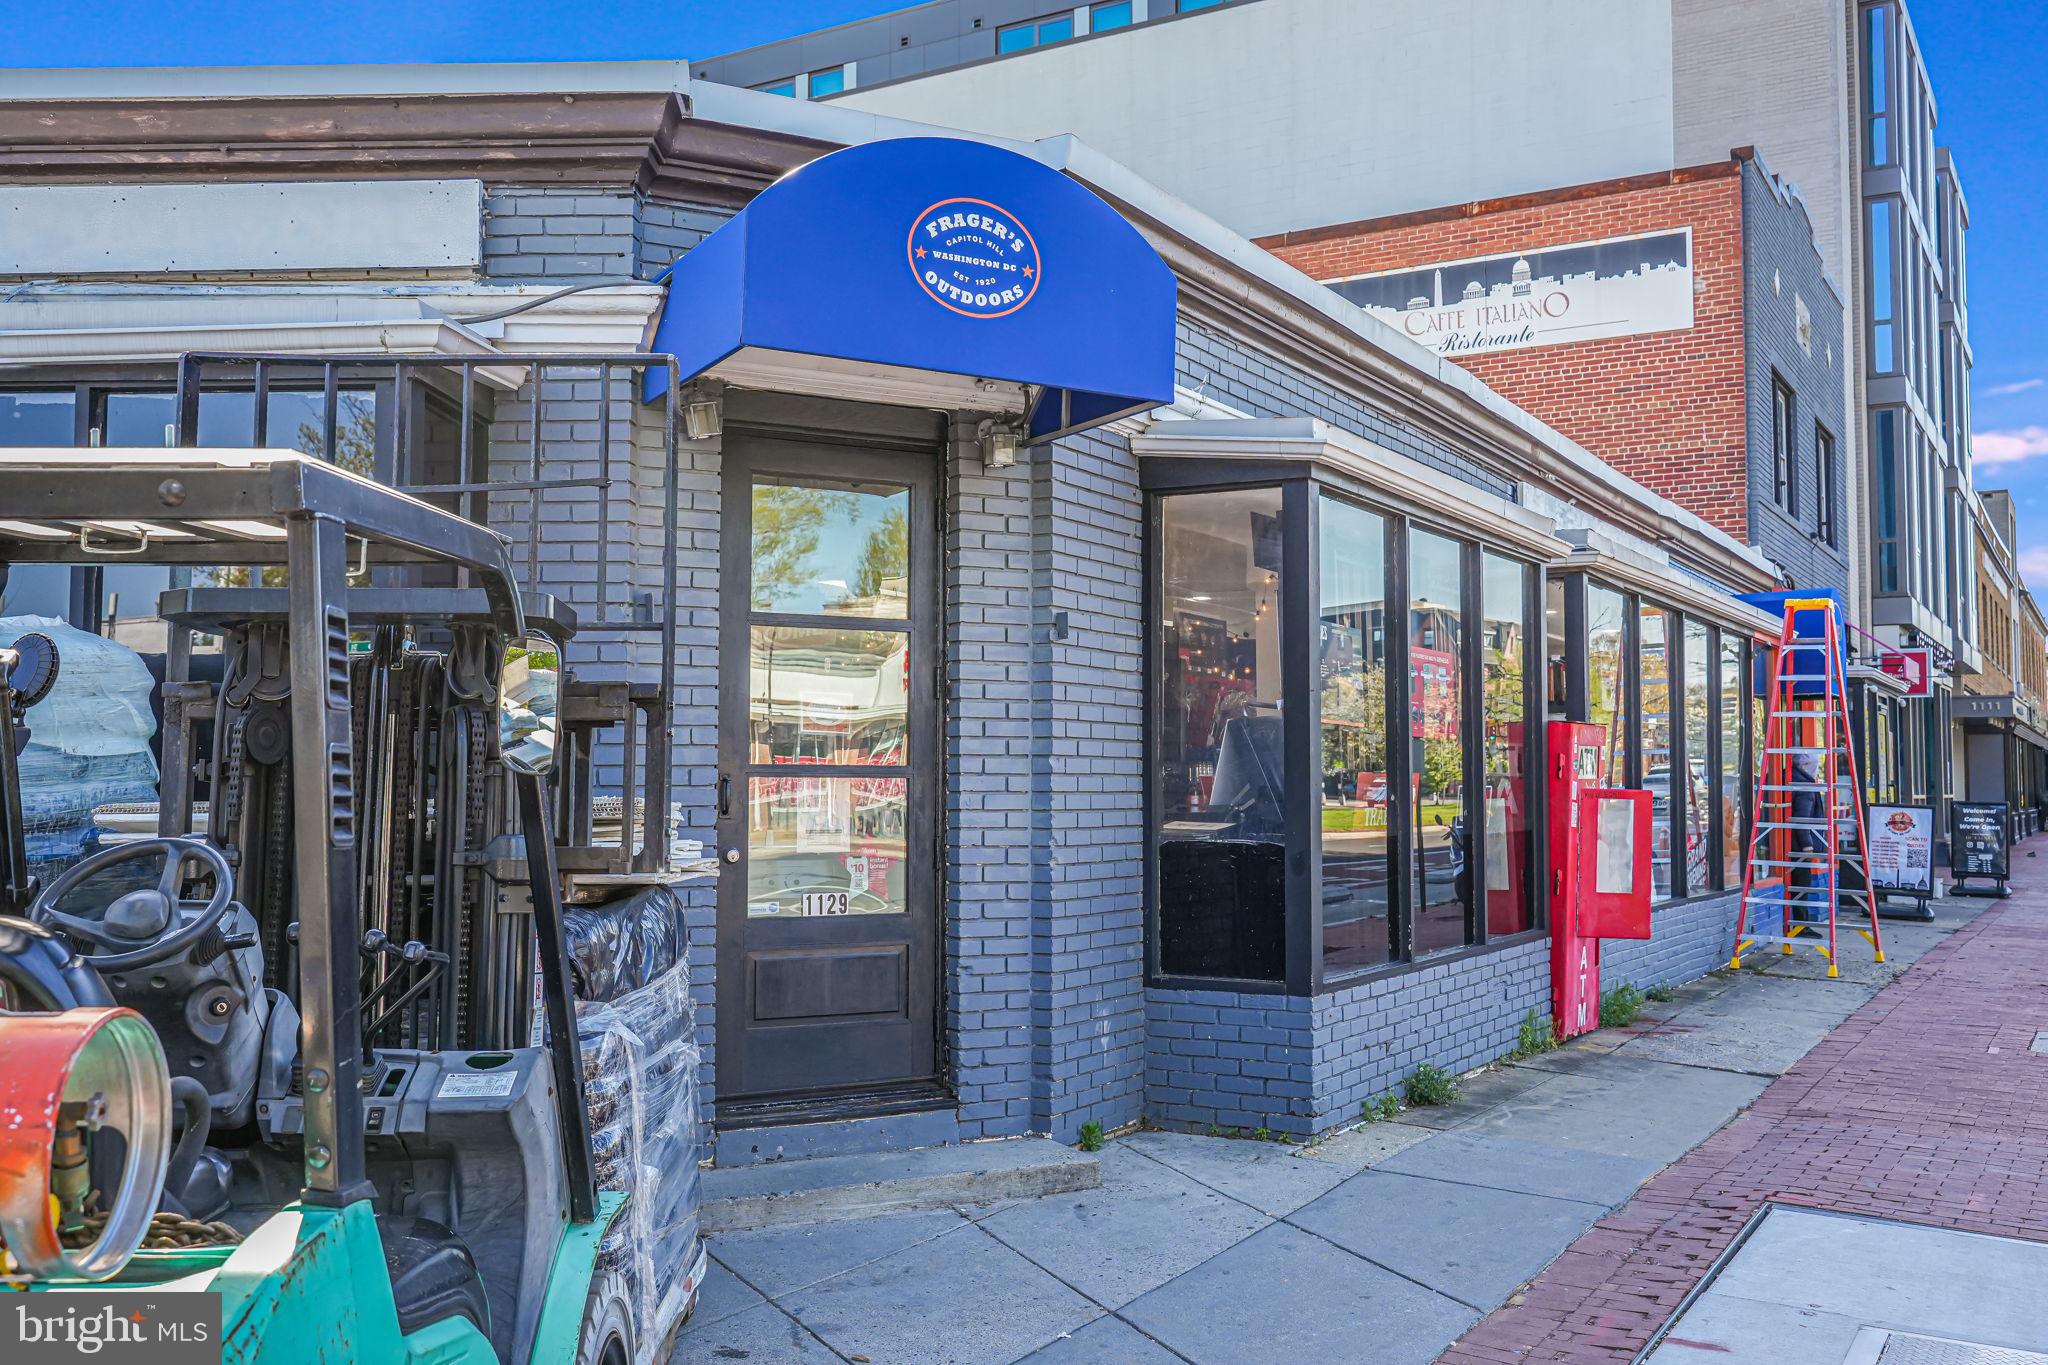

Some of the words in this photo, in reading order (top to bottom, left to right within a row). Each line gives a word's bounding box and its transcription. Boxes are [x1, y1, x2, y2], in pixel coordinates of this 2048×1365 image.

[925, 213, 1025, 253] FRAGER'S
[946, 235, 984, 247] CAPITOL
[986, 240, 1004, 256] HILL
[932, 250, 1000, 269] WASHINGTON
[1003, 263, 1017, 272] DC
[925, 271, 1024, 307] OUTDOORS
[953, 270, 970, 283] EST
[975, 277, 996, 286] 1920
[1405, 310, 1465, 336] CAFFE
[1476, 291, 1570, 326] ITALIANO
[1438, 325, 1535, 352] Ristorante
[1981, 824, 2001, 832] Open
[805, 893, 848, 915] 1129
[1578, 946, 1588, 1027] ATM
